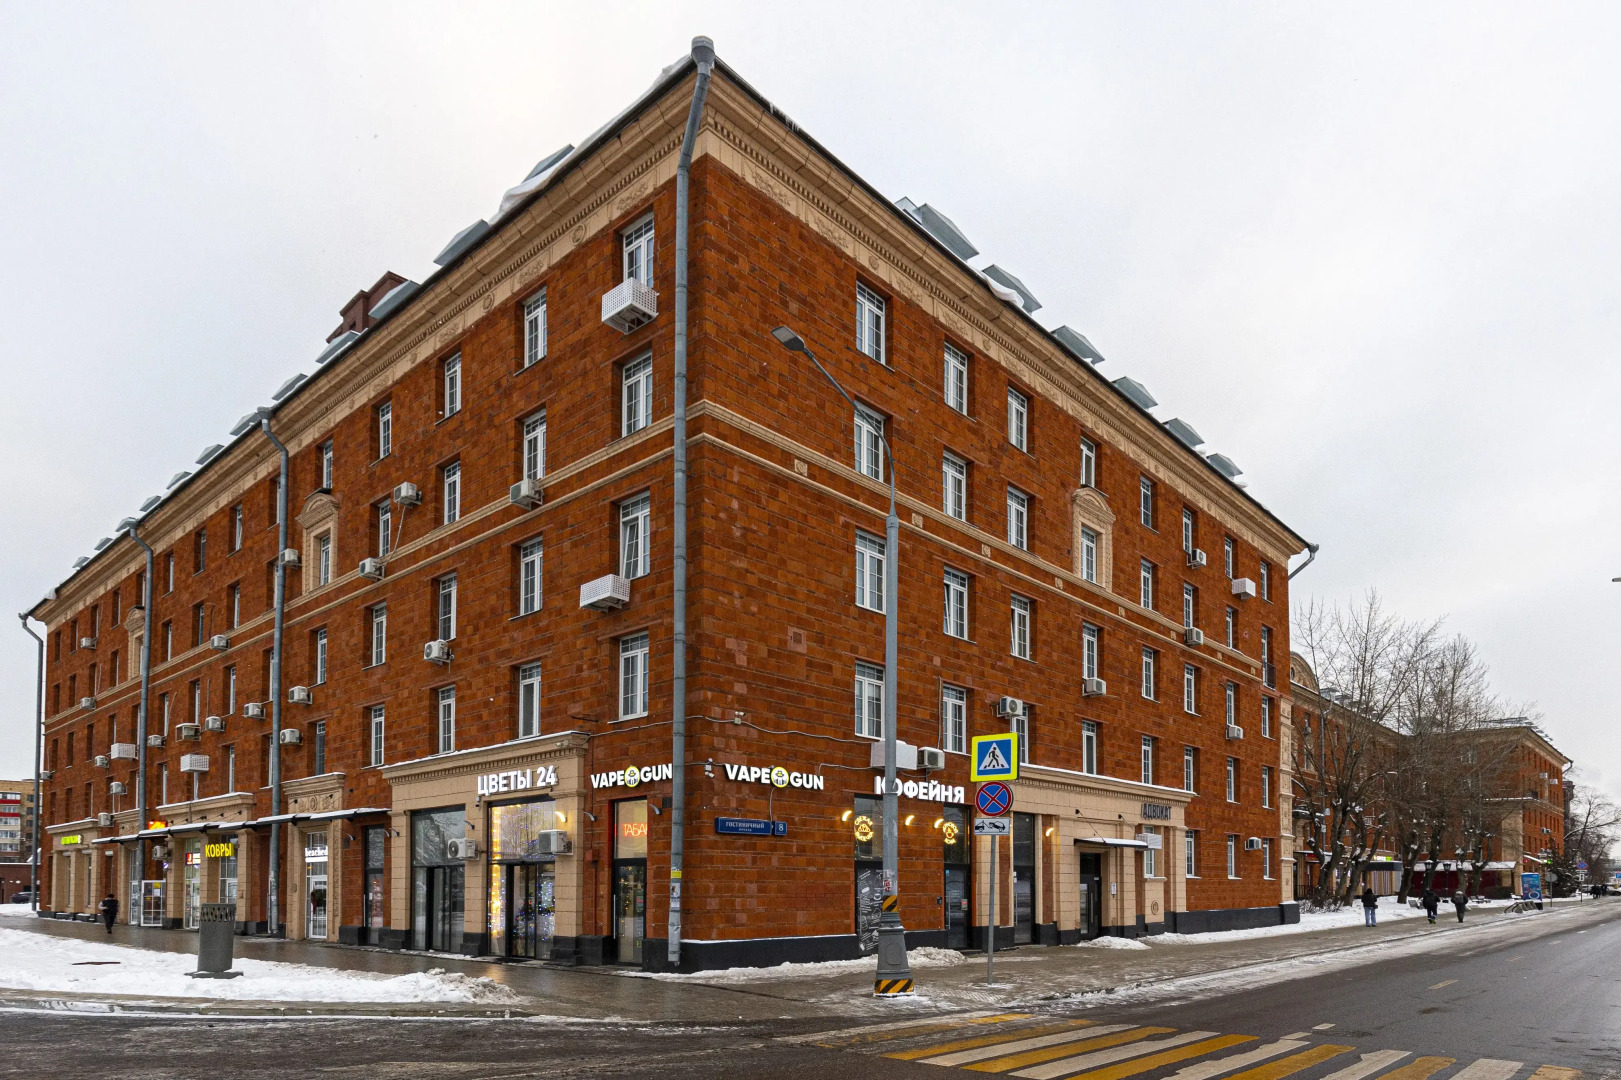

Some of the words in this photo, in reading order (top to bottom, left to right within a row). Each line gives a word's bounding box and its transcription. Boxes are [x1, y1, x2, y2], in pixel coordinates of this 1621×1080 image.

[477, 769, 533, 796] ЦВЕТЫ
[536, 765, 558, 788] 24
[590, 773, 625, 789] VAPE
[640, 763, 673, 783] GUN
[724, 763, 771, 784] VAPE
[789, 771, 824, 790] GUN
[1141, 803, 1172, 820] АДВОКАТ
[622, 823, 648, 838] ТАБА
[725, 821, 765, 829] ГОСТИНИЧНЫЙ
[778, 823, 784, 832] 8
[205, 843, 233, 858] КОВРЫ
